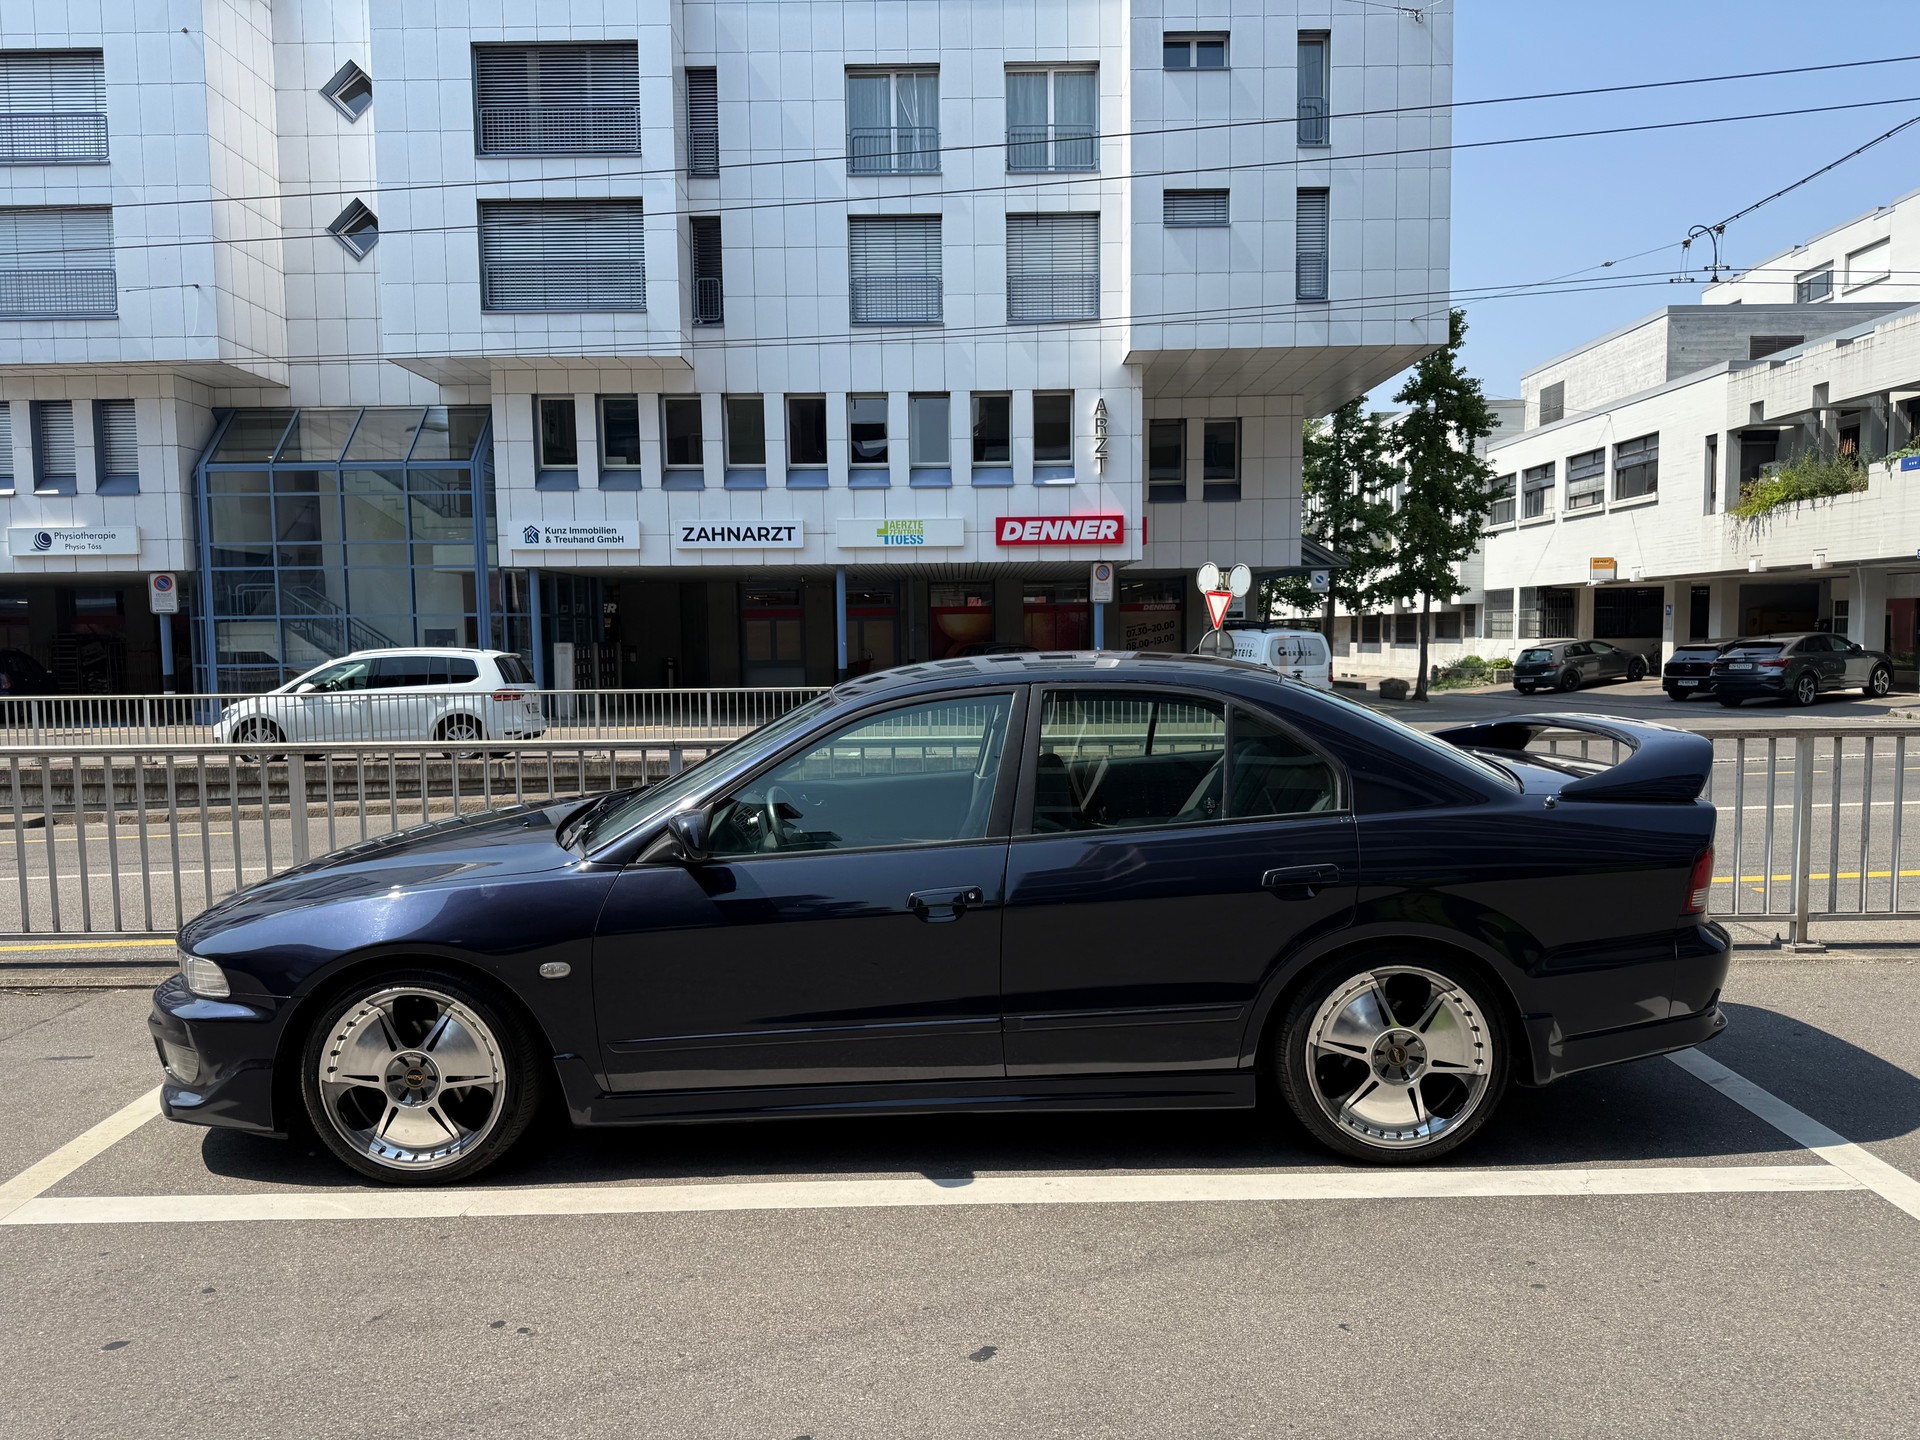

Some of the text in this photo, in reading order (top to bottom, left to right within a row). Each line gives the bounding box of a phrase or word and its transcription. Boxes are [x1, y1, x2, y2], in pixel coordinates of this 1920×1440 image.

[1094, 398, 1108, 473] ARZT
[889, 520, 923, 529] AERZTE
[544, 526, 617, 535] Kunz Immobilien
[682, 526, 796, 542] ZAHNARZT
[1001, 519, 1118, 541] DENNER
[54, 531, 117, 541] Physiotherapie
[545, 535, 625, 544] & Treuhand GmbH
[64, 543, 86, 551] Physio
[1143, 603, 1176, 611] DENNER
